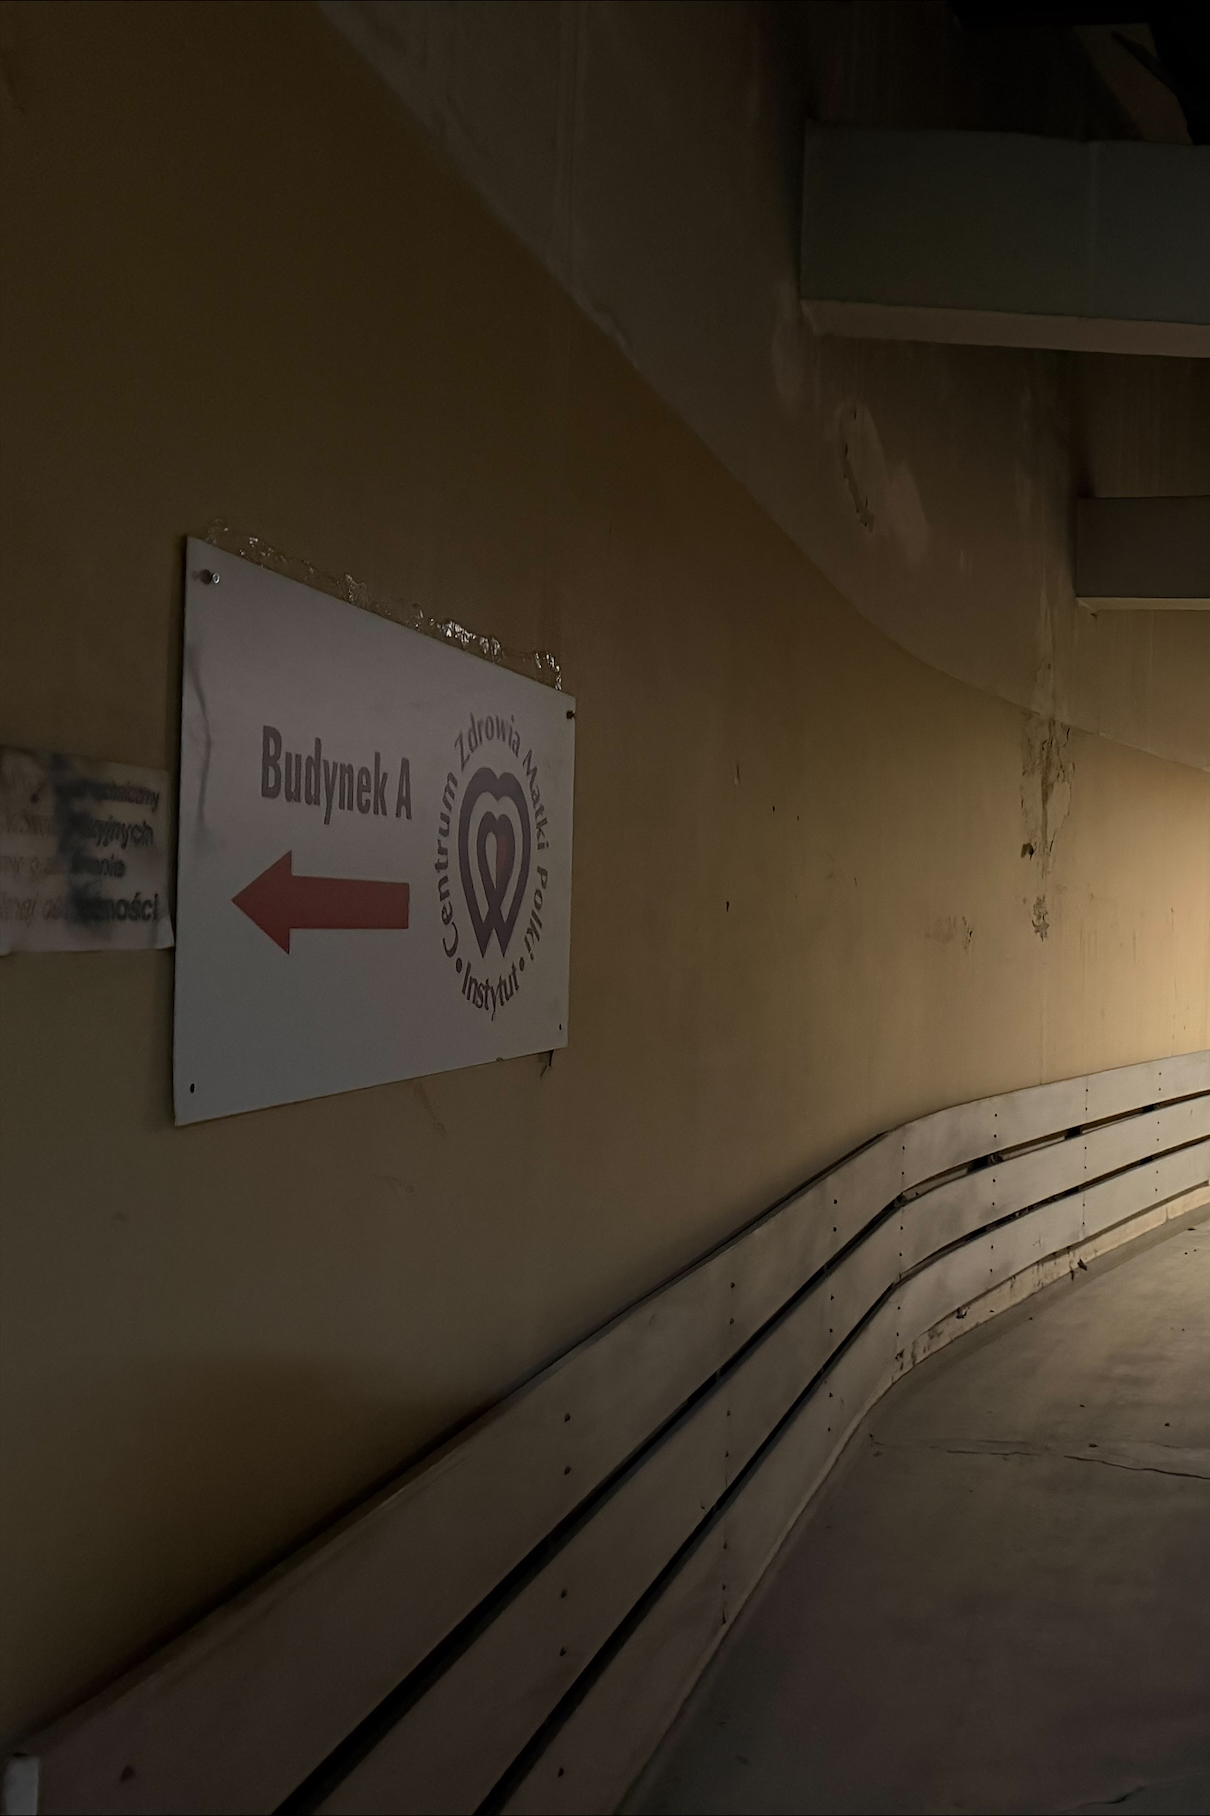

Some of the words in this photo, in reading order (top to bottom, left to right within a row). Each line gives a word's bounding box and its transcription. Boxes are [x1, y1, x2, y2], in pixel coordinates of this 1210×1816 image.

[261, 725, 388, 825] Budynek
[395, 757, 412, 820] A
[454, 712, 520, 771] Zdrowia
[523, 750, 549, 850] Matki
[434, 772, 459, 957] Centrum
[524, 866, 548, 961] Polki
[462, 962, 519, 1021] Instytut
